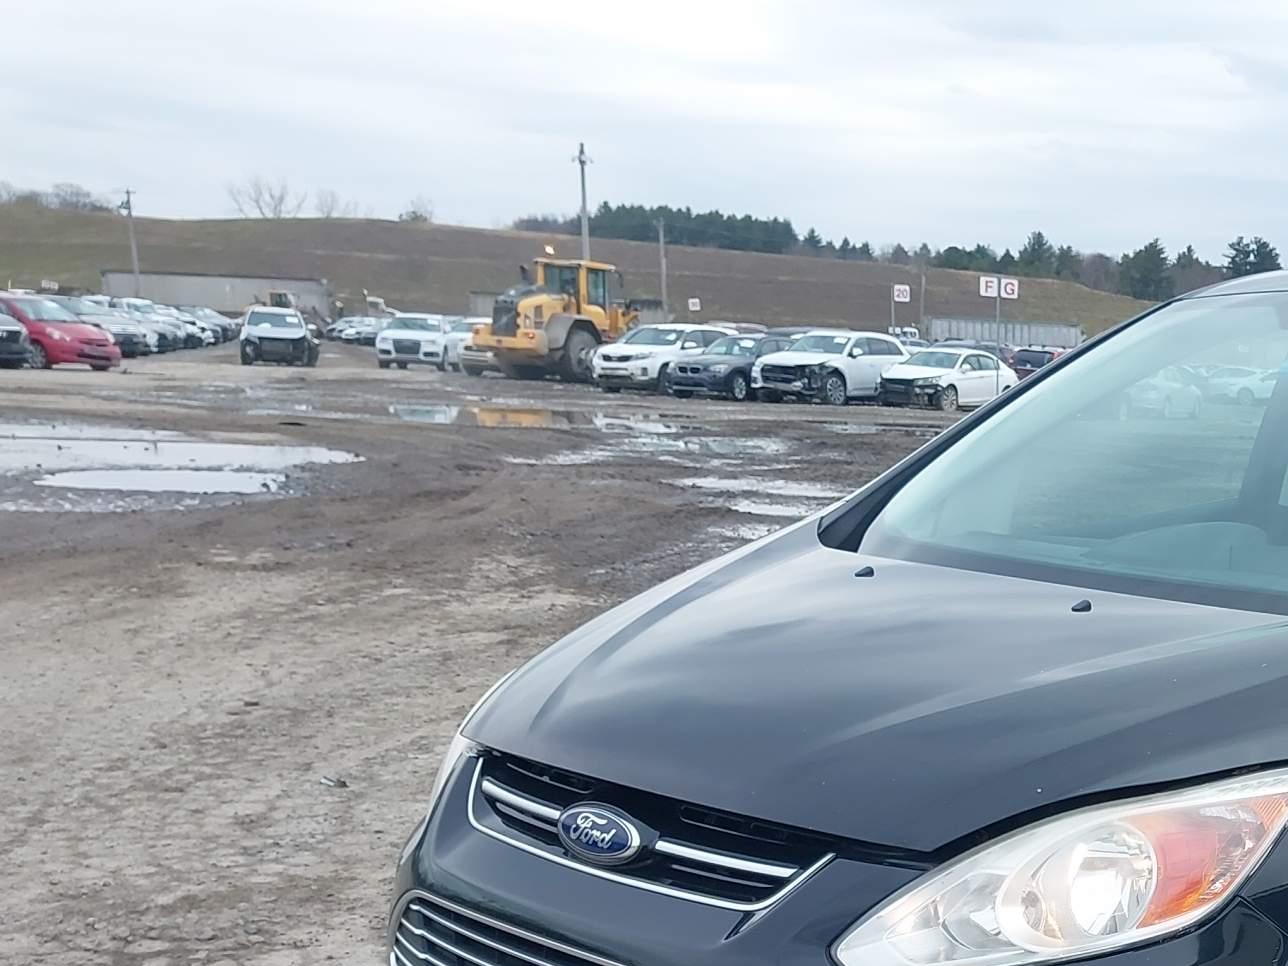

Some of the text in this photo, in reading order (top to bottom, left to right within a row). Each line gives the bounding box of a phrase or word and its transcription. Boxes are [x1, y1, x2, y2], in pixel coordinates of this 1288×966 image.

[984, 279, 995, 294] F
[1004, 281, 1016, 297] G
[569, 812, 617, 849] Ford
